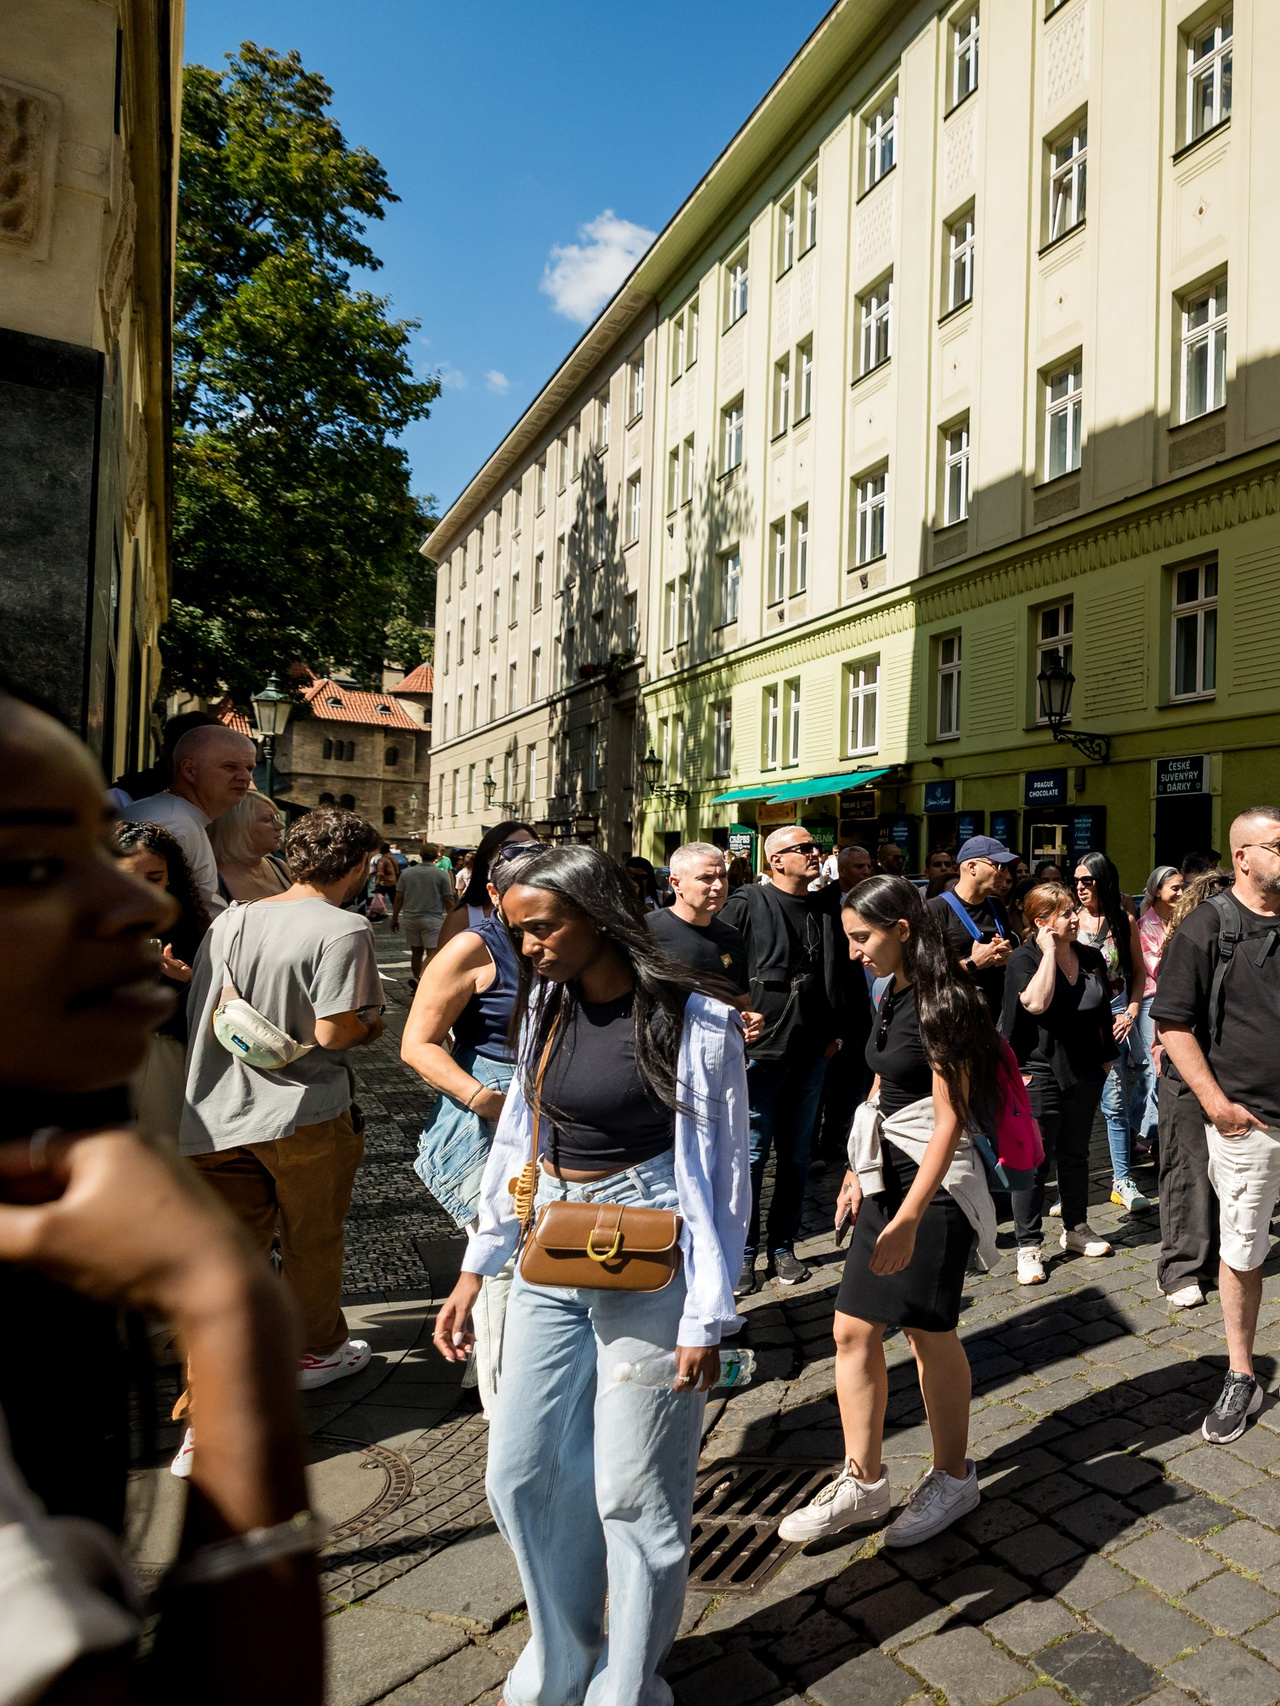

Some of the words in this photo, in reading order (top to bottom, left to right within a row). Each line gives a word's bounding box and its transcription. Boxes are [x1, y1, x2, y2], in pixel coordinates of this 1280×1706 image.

[1168, 759, 1191, 771] ČESKÉ
[1160, 770, 1199, 782] SUVENÝRY
[1033, 780, 1054, 789] PRAGUE
[1166, 781, 1192, 792] DÁRKY
[1029, 788, 1059, 798] CHOCOLATE
